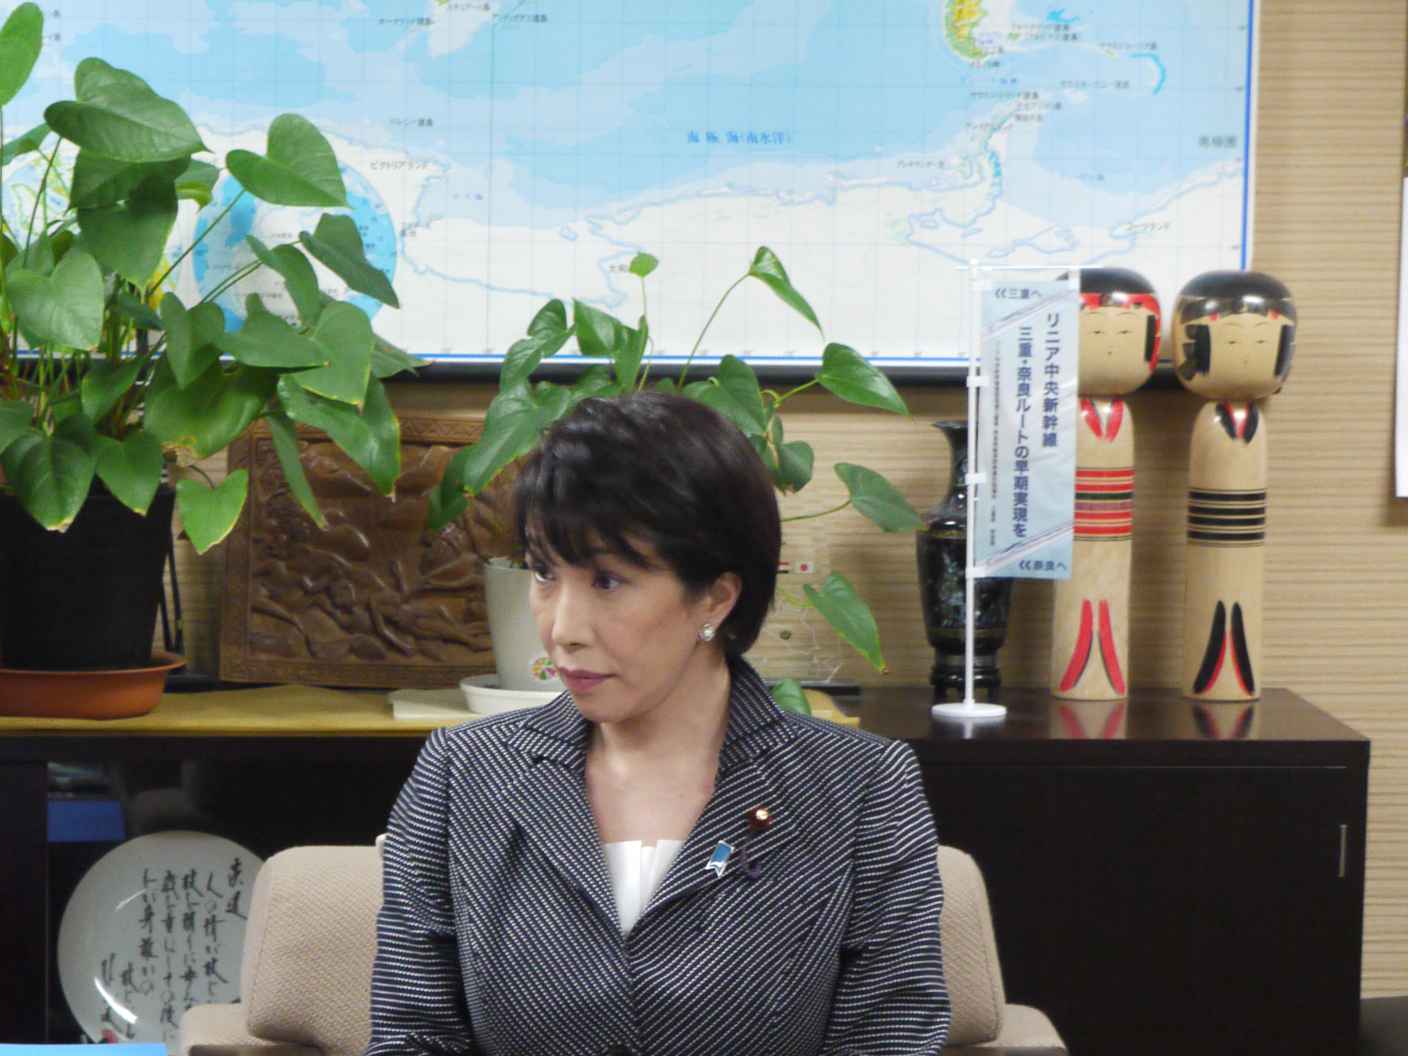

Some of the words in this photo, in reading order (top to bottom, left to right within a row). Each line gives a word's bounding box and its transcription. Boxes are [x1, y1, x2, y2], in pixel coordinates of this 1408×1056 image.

[1041, 312, 1061, 448] リニア中央新幹線
